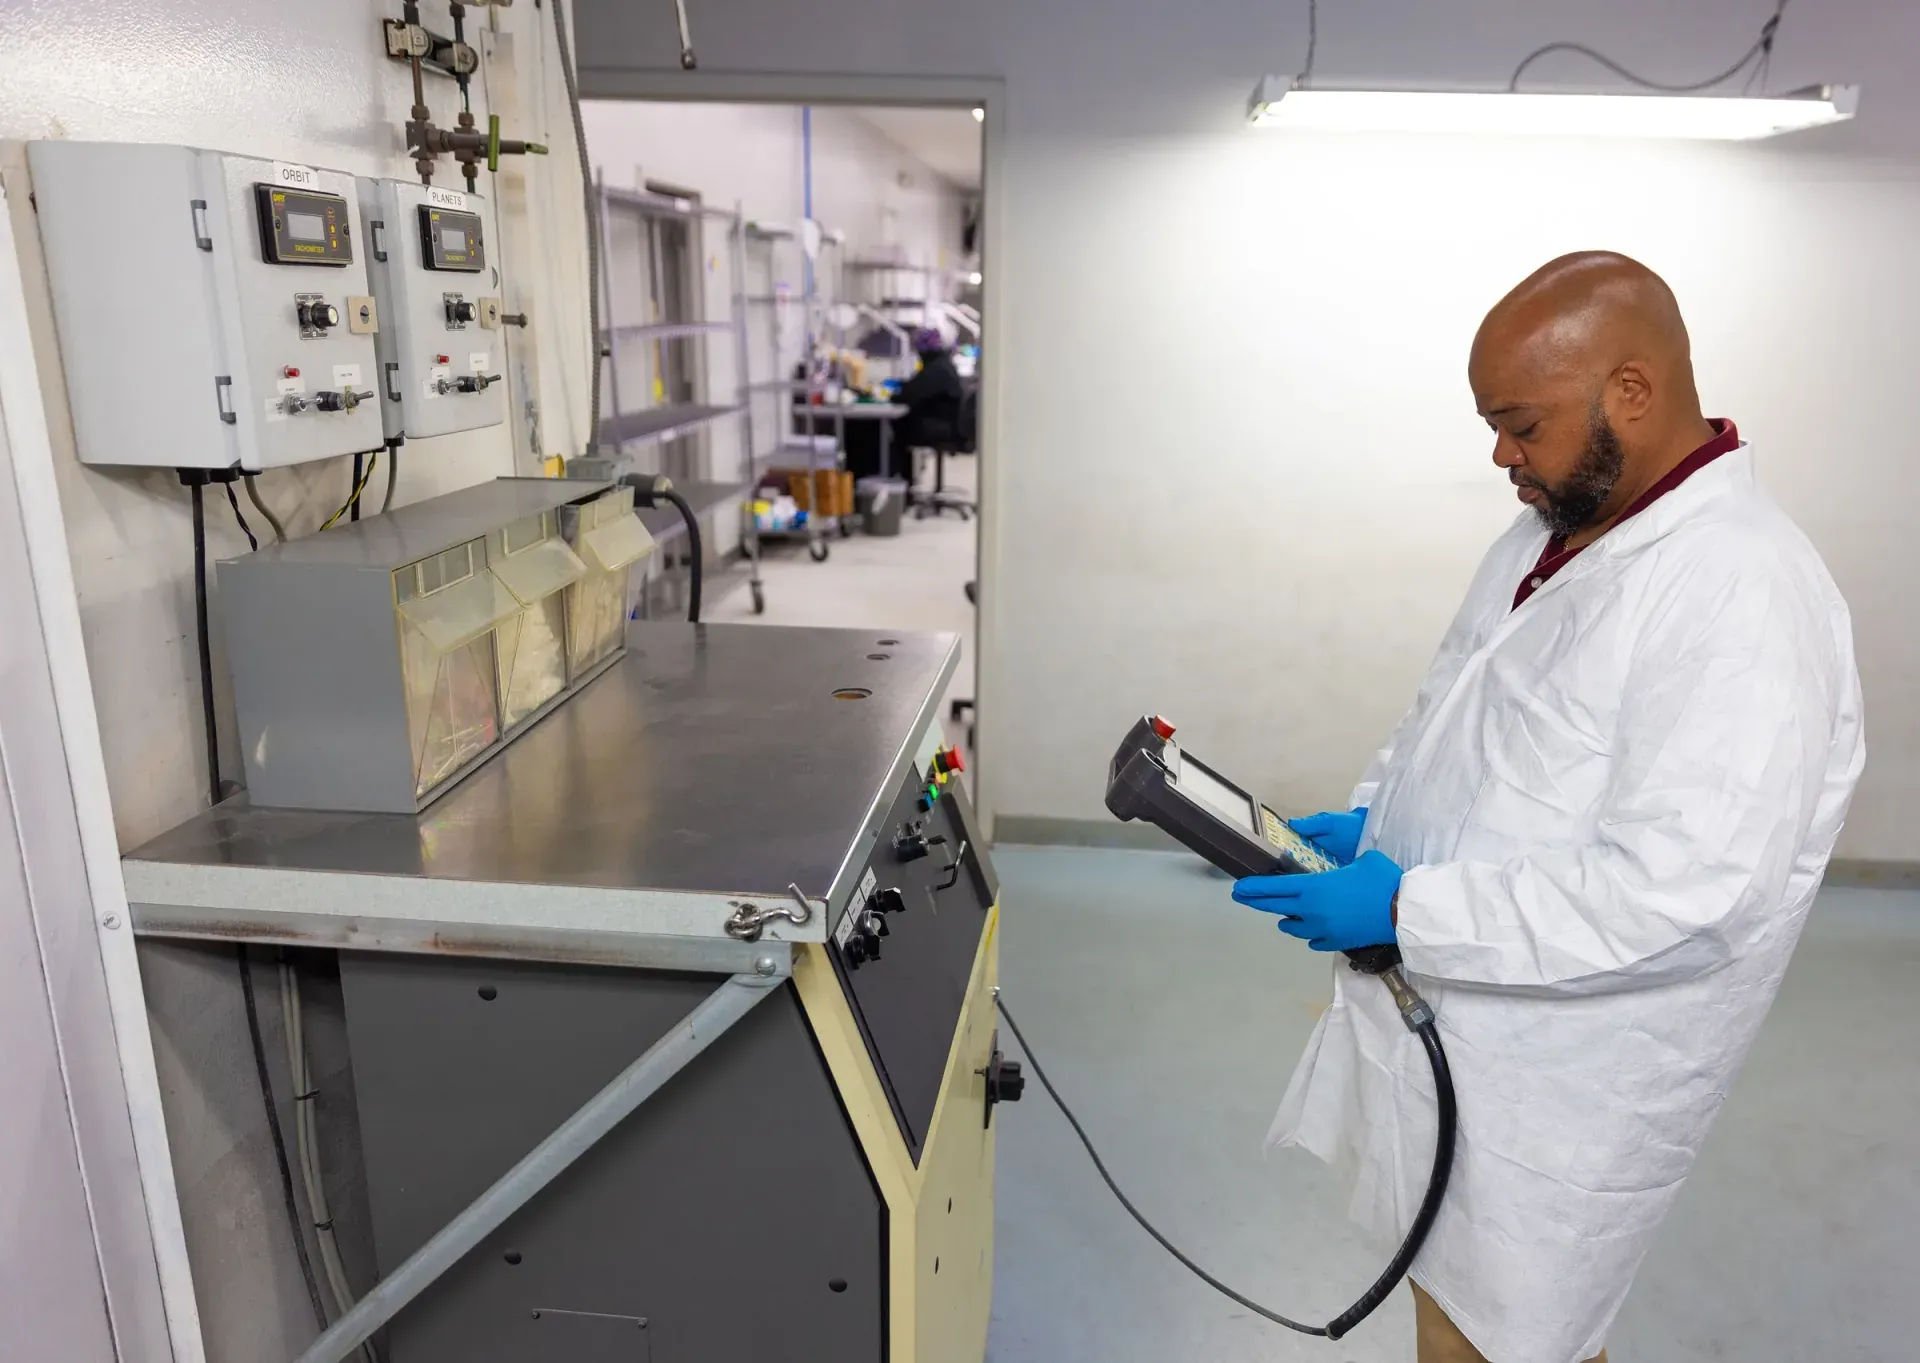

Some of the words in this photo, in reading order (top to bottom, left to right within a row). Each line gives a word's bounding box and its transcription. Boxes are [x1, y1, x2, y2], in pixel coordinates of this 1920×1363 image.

[282, 168, 310, 183] ORBIT
[432, 191, 462, 205] PLANETS
[294, 244, 325, 253] TACHOMETER
